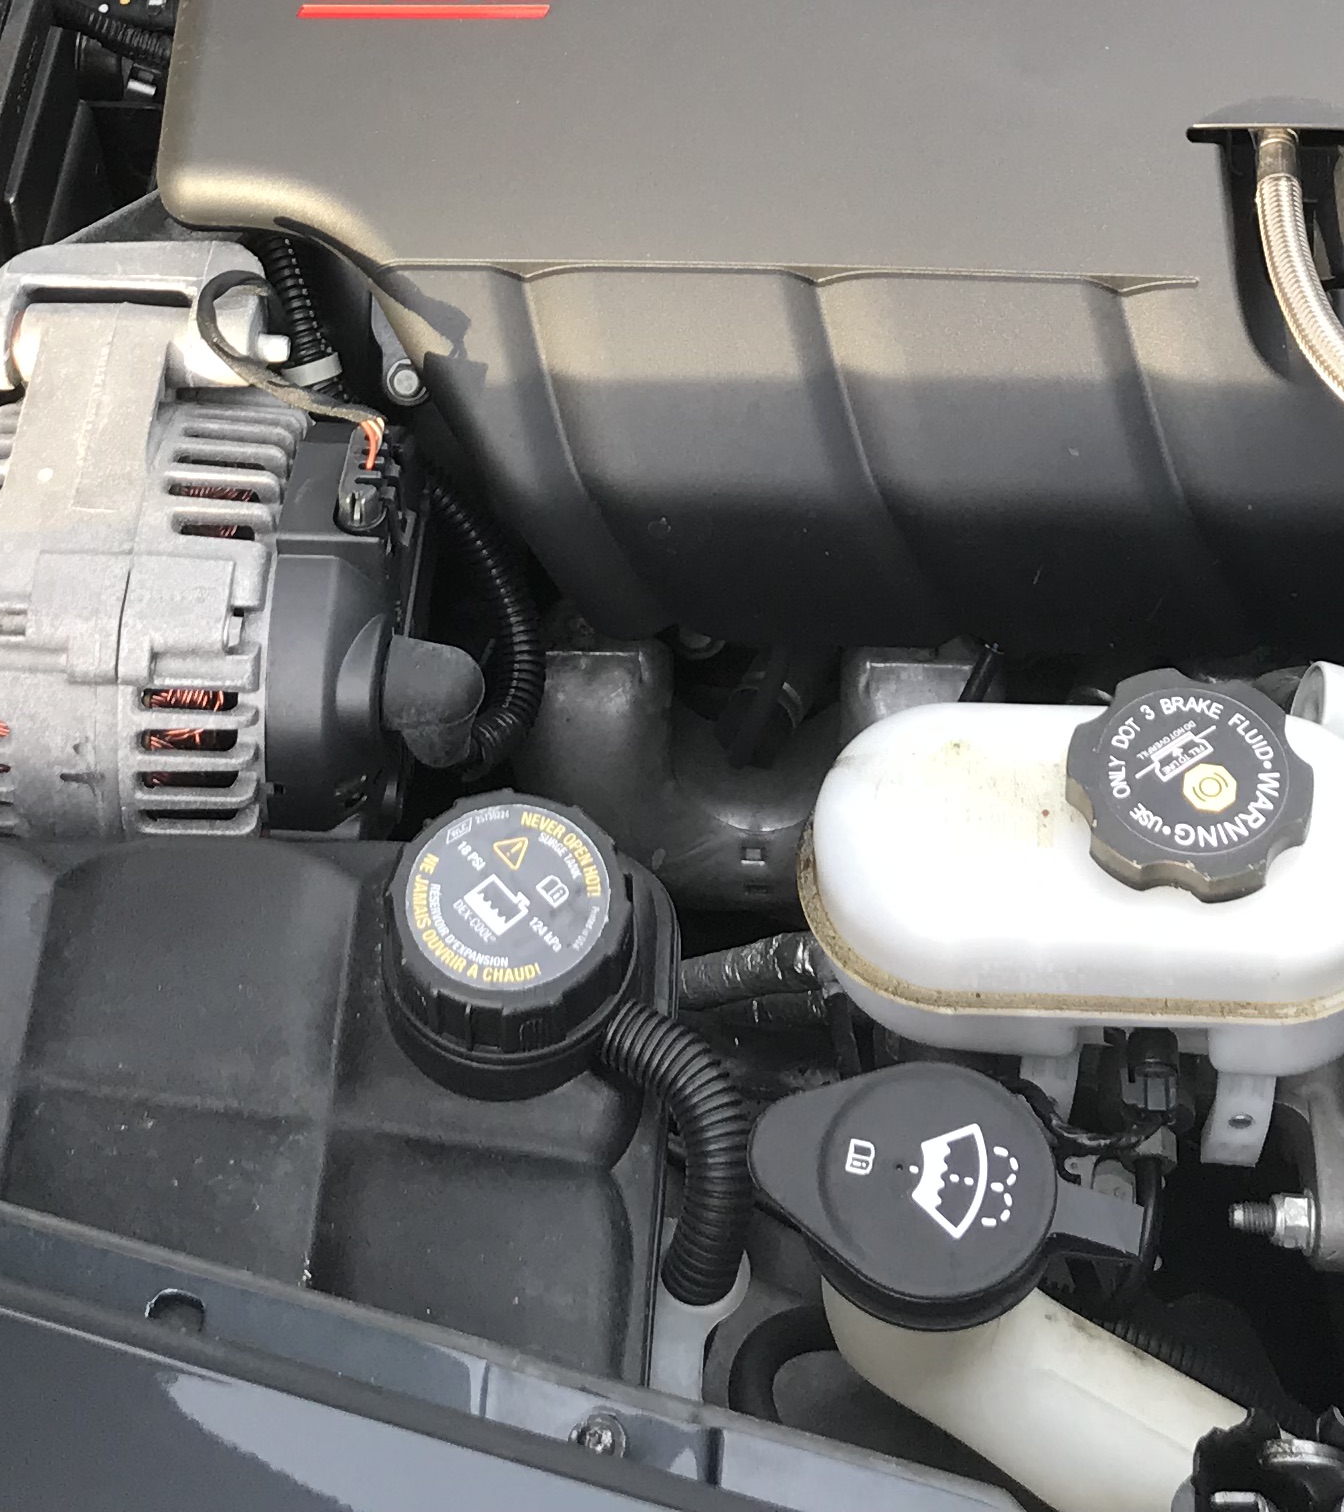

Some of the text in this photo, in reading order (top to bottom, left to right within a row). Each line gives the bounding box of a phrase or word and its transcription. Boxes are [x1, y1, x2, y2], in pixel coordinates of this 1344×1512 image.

[1136, 720, 1197, 760] DO NOT OVERFILL
[1108, 696, 1281, 848] WARNING USE ONLY DOT 3 BRAKE FLUID
[1161, 744, 1206, 776] FILL TO LINE
[419, 852, 440, 874] NE
[458, 840, 486, 872] 18 PSI
[520, 811, 602, 898] NEVER OPEN HOT!
[538, 832, 582, 880] SURGE TANK
[412, 874, 432, 930] JAMAIS
[422, 928, 468, 973] OUVRIR
[444, 934, 509, 968] D'EXPANSION
[529, 916, 562, 954] 124 kPa
[482, 962, 542, 983] CHAUD!
